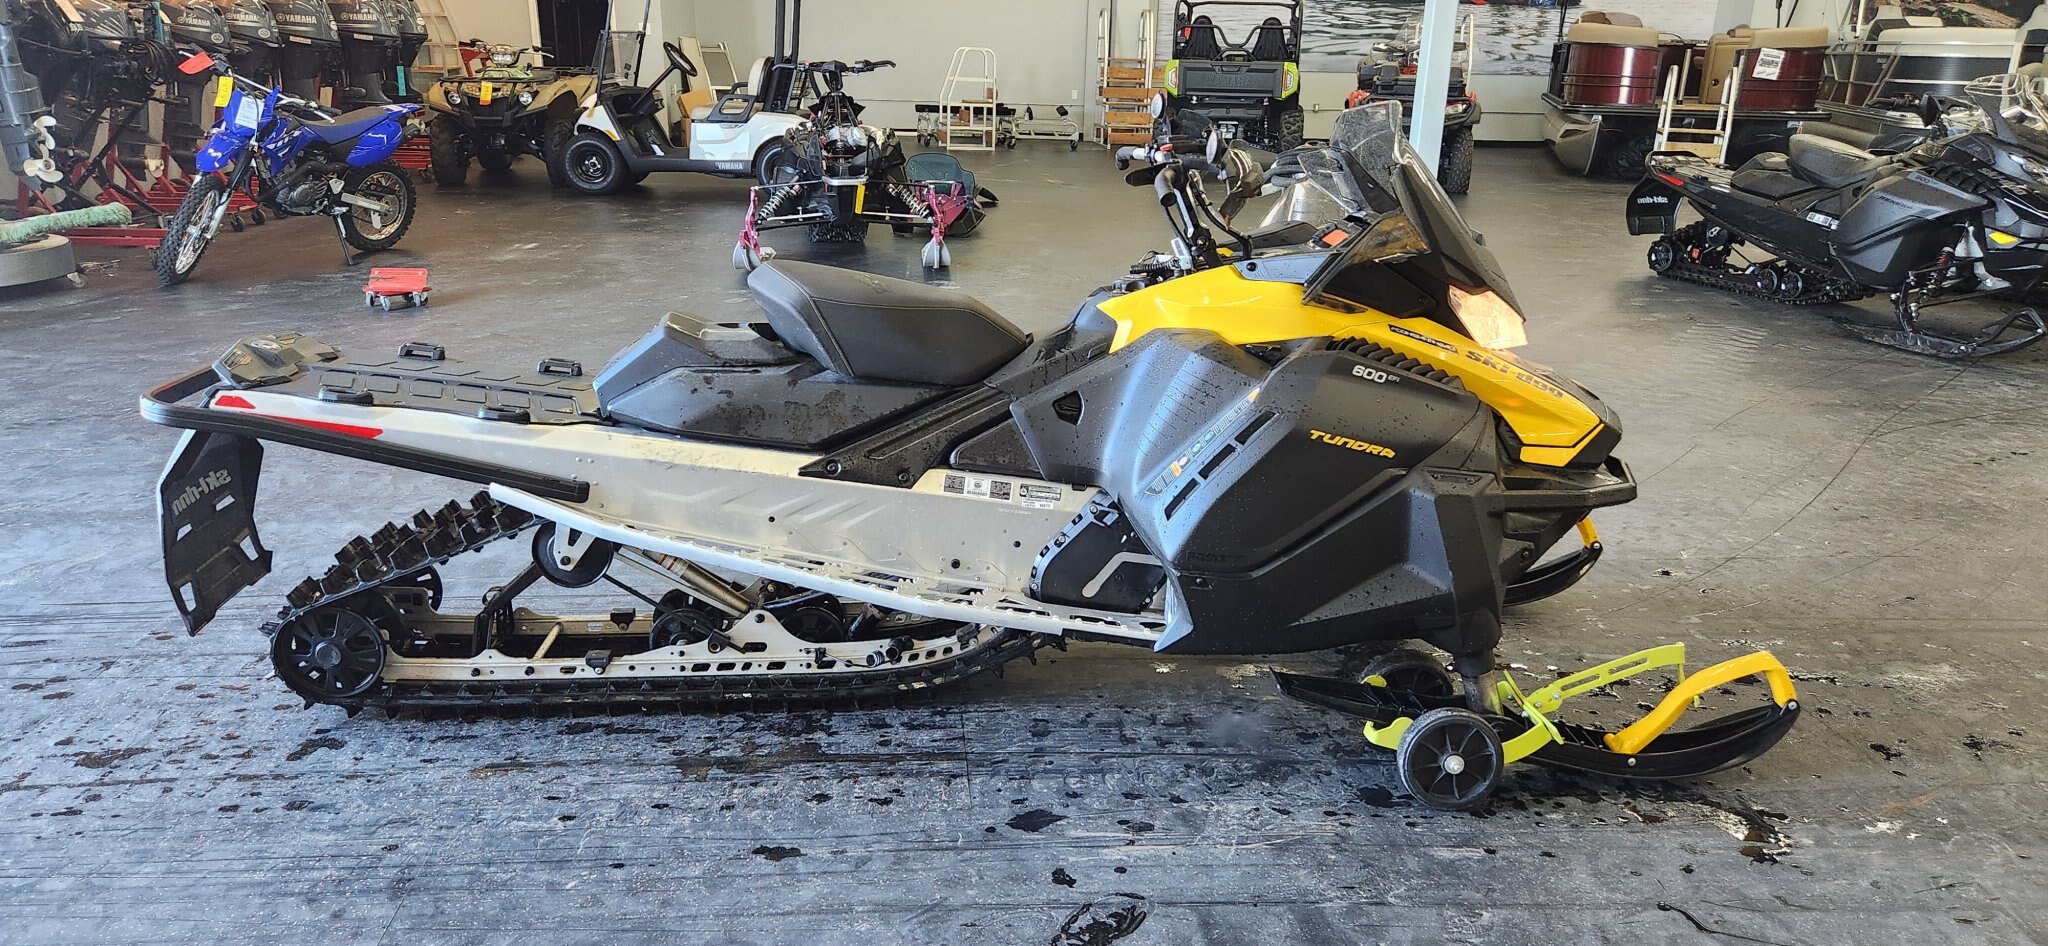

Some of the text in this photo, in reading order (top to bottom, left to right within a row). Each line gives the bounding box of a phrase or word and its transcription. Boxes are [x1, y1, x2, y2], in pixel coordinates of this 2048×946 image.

[232, 13, 258, 22] YAMAHA
[284, 14, 317, 24] YAMAHA
[348, 12, 378, 22] YAMAHA
[185, 18, 211, 27] YAMAHA
[717, 161, 743, 170] YAMAHA
[1352, 364, 1388, 384] 600
[1310, 429, 1396, 459] TUNDRA
